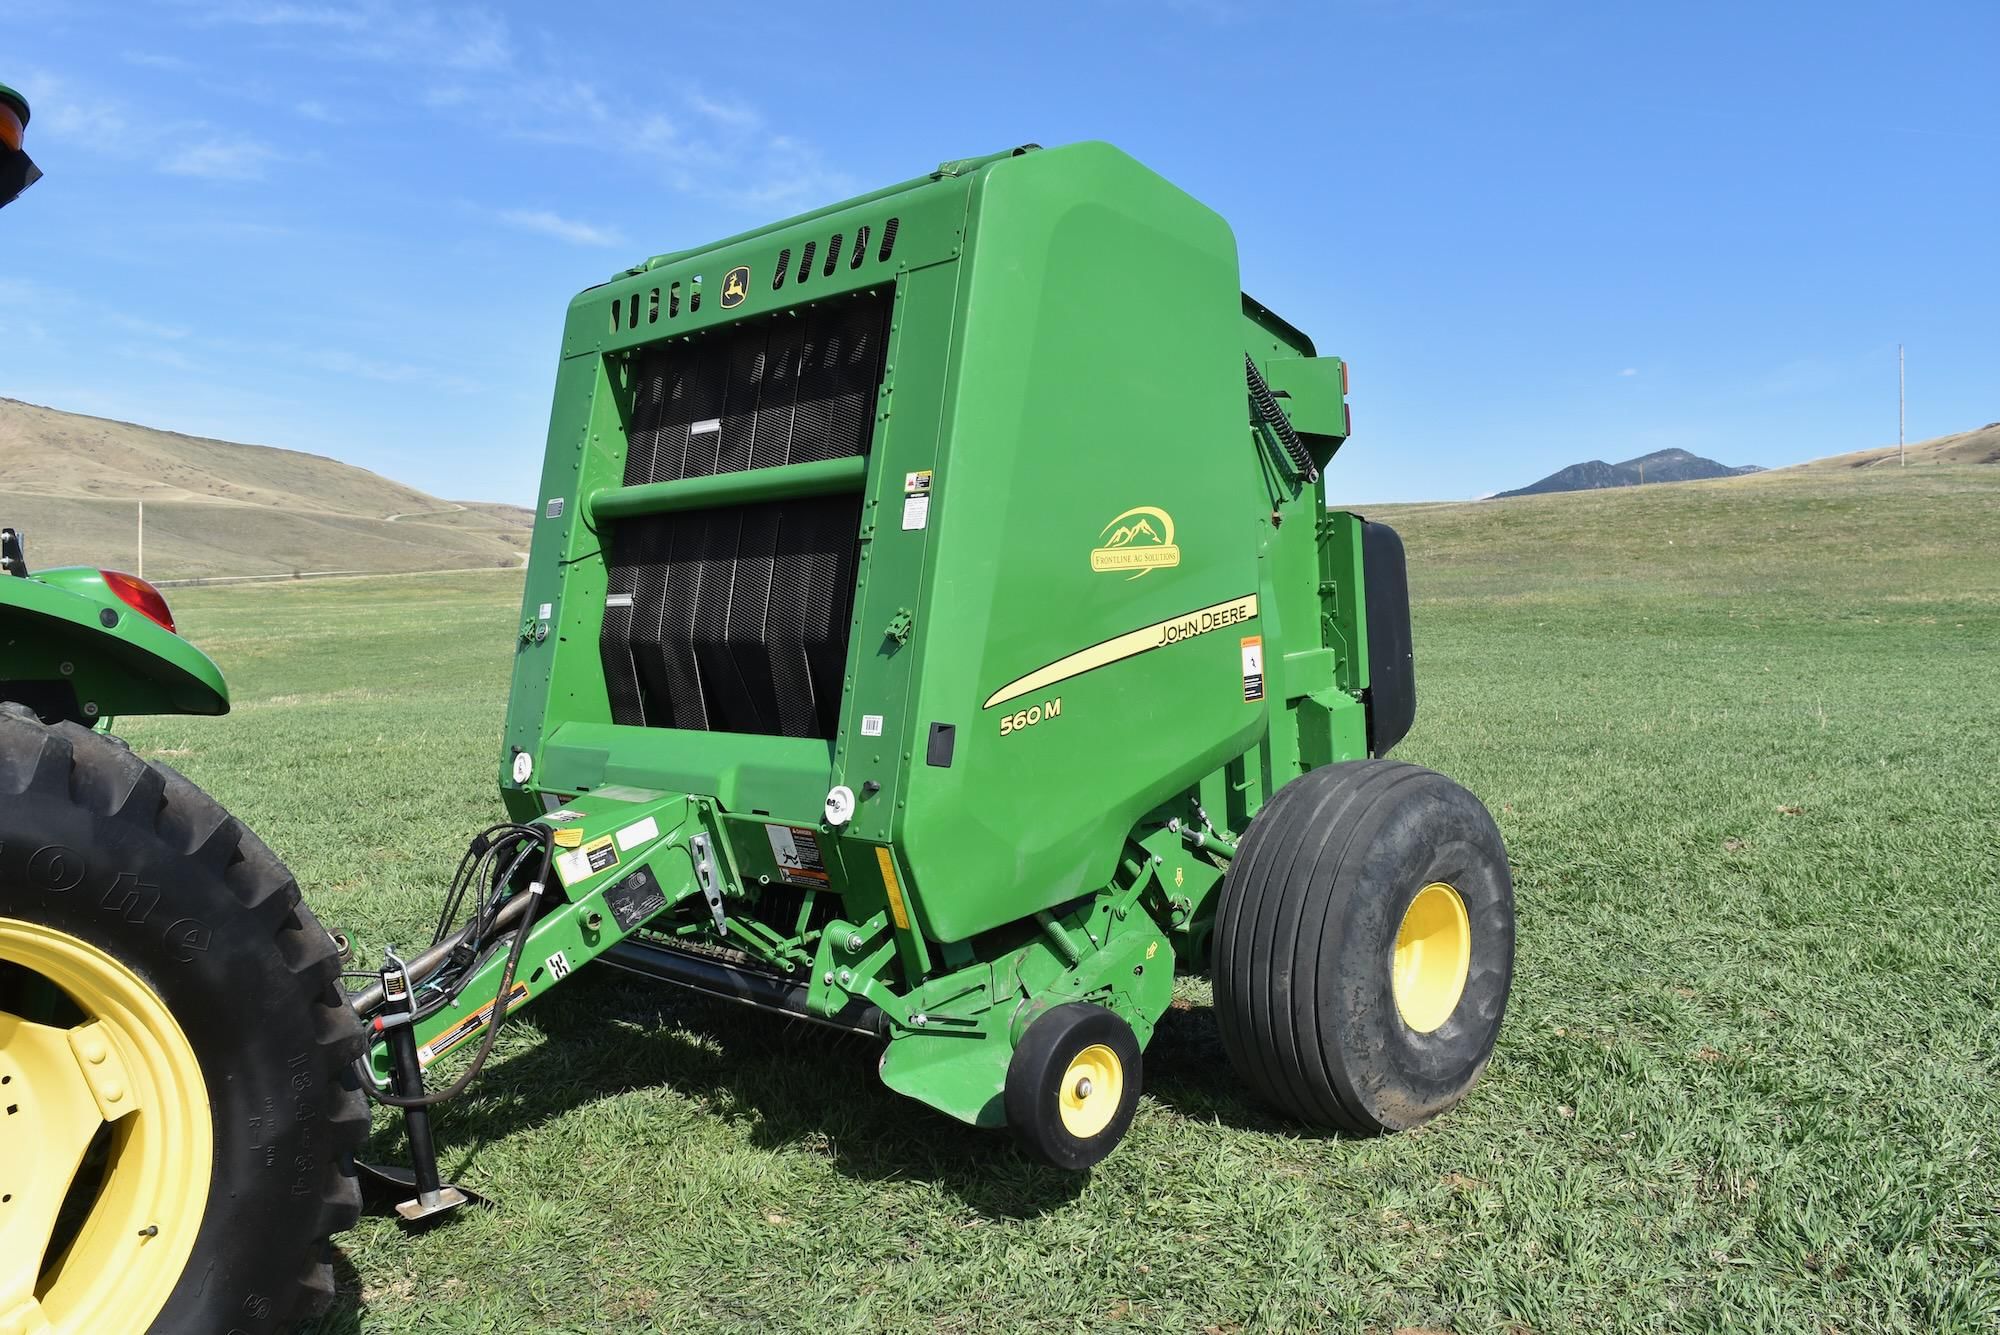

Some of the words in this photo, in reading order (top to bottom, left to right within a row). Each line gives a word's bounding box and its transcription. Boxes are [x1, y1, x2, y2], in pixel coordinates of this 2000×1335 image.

[1095, 555, 1131, 565] FRONTLINE
[1134, 555, 1143, 563] AG
[1144, 552, 1176, 562] SOLUTIONS
[1158, 619, 1198, 644] JOHN
[1201, 605, 1247, 630] DEERE
[1000, 705, 1041, 736] 560
[1044, 697, 1062, 720] M
[0, 841, 213, 962] one
